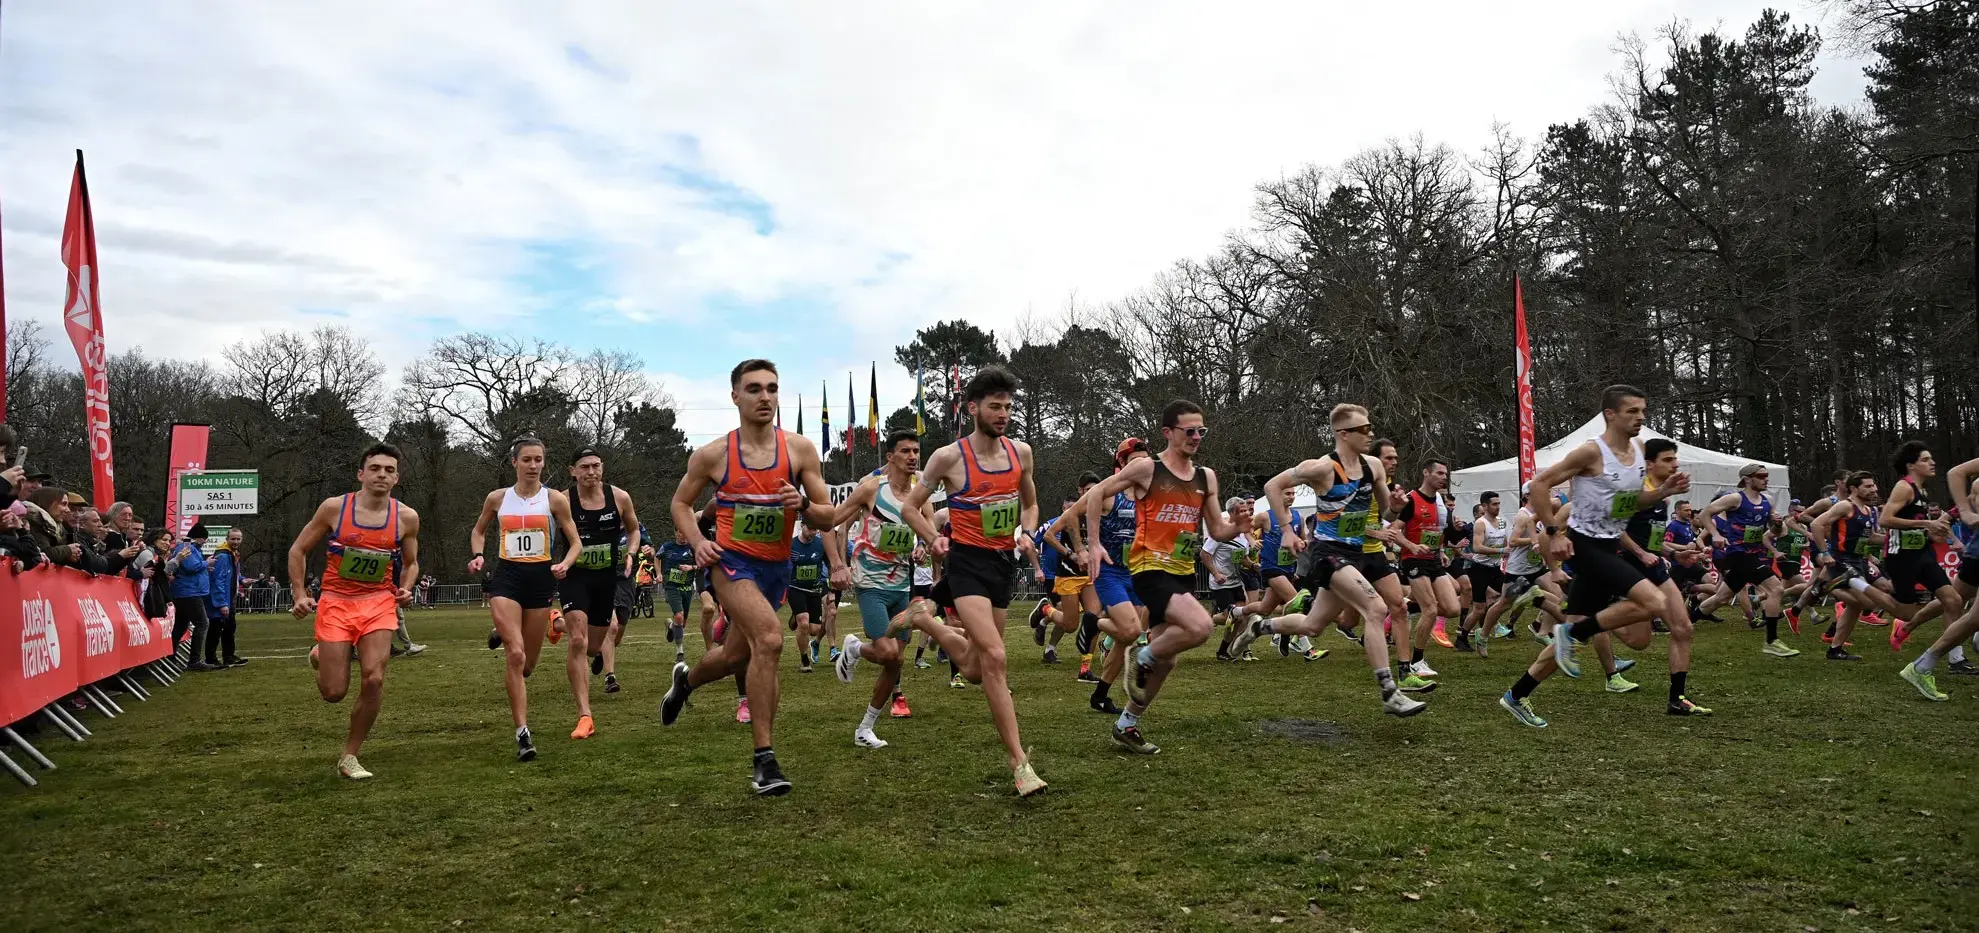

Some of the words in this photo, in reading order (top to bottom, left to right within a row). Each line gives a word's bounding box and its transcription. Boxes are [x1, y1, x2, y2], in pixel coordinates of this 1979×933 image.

[187, 478, 213, 486] 10KM
[215, 478, 254, 486] NATURE
[207, 492, 224, 500] SAS
[743, 514, 775, 534] 258
[992, 508, 1014, 529] 274
[517, 536, 531, 551] 10
[887, 530, 910, 546] 244
[349, 557, 379, 575] 279
[584, 551, 605, 565] 204
[23, 591, 46, 636] ouest
[84, 619, 110, 657] france
[22, 630, 49, 679] france
